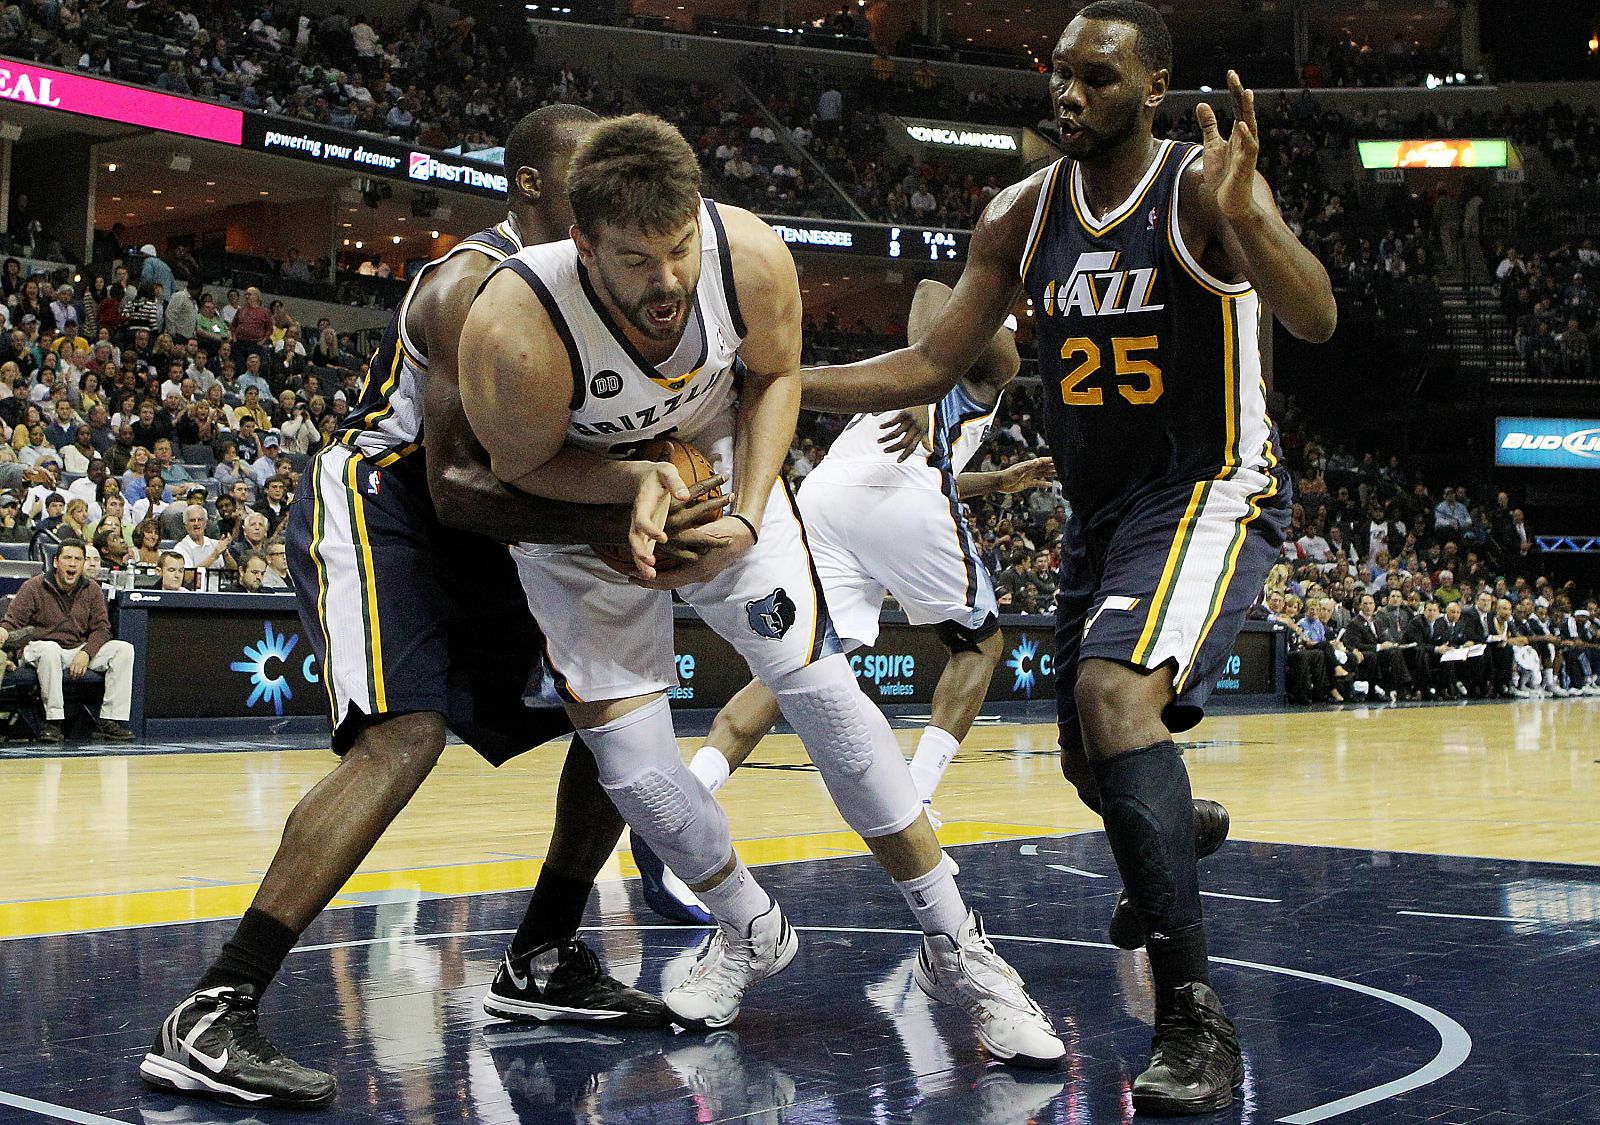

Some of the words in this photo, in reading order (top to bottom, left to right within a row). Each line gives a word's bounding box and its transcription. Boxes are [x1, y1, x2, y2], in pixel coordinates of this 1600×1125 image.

[264, 131, 322, 157] powering
[323, 143, 353, 159] your
[353, 146, 397, 168] dreams
[429, 159, 460, 182] FIRST
[772, 225, 853, 247] TENNESSEE
[1050, 251, 1165, 317] JAZZ
[1060, 334, 1164, 406] 25
[1501, 432, 1563, 450] BUD
[850, 655, 862, 678] c
[863, 655, 915, 685] spire
[879, 681, 914, 696] wireless
